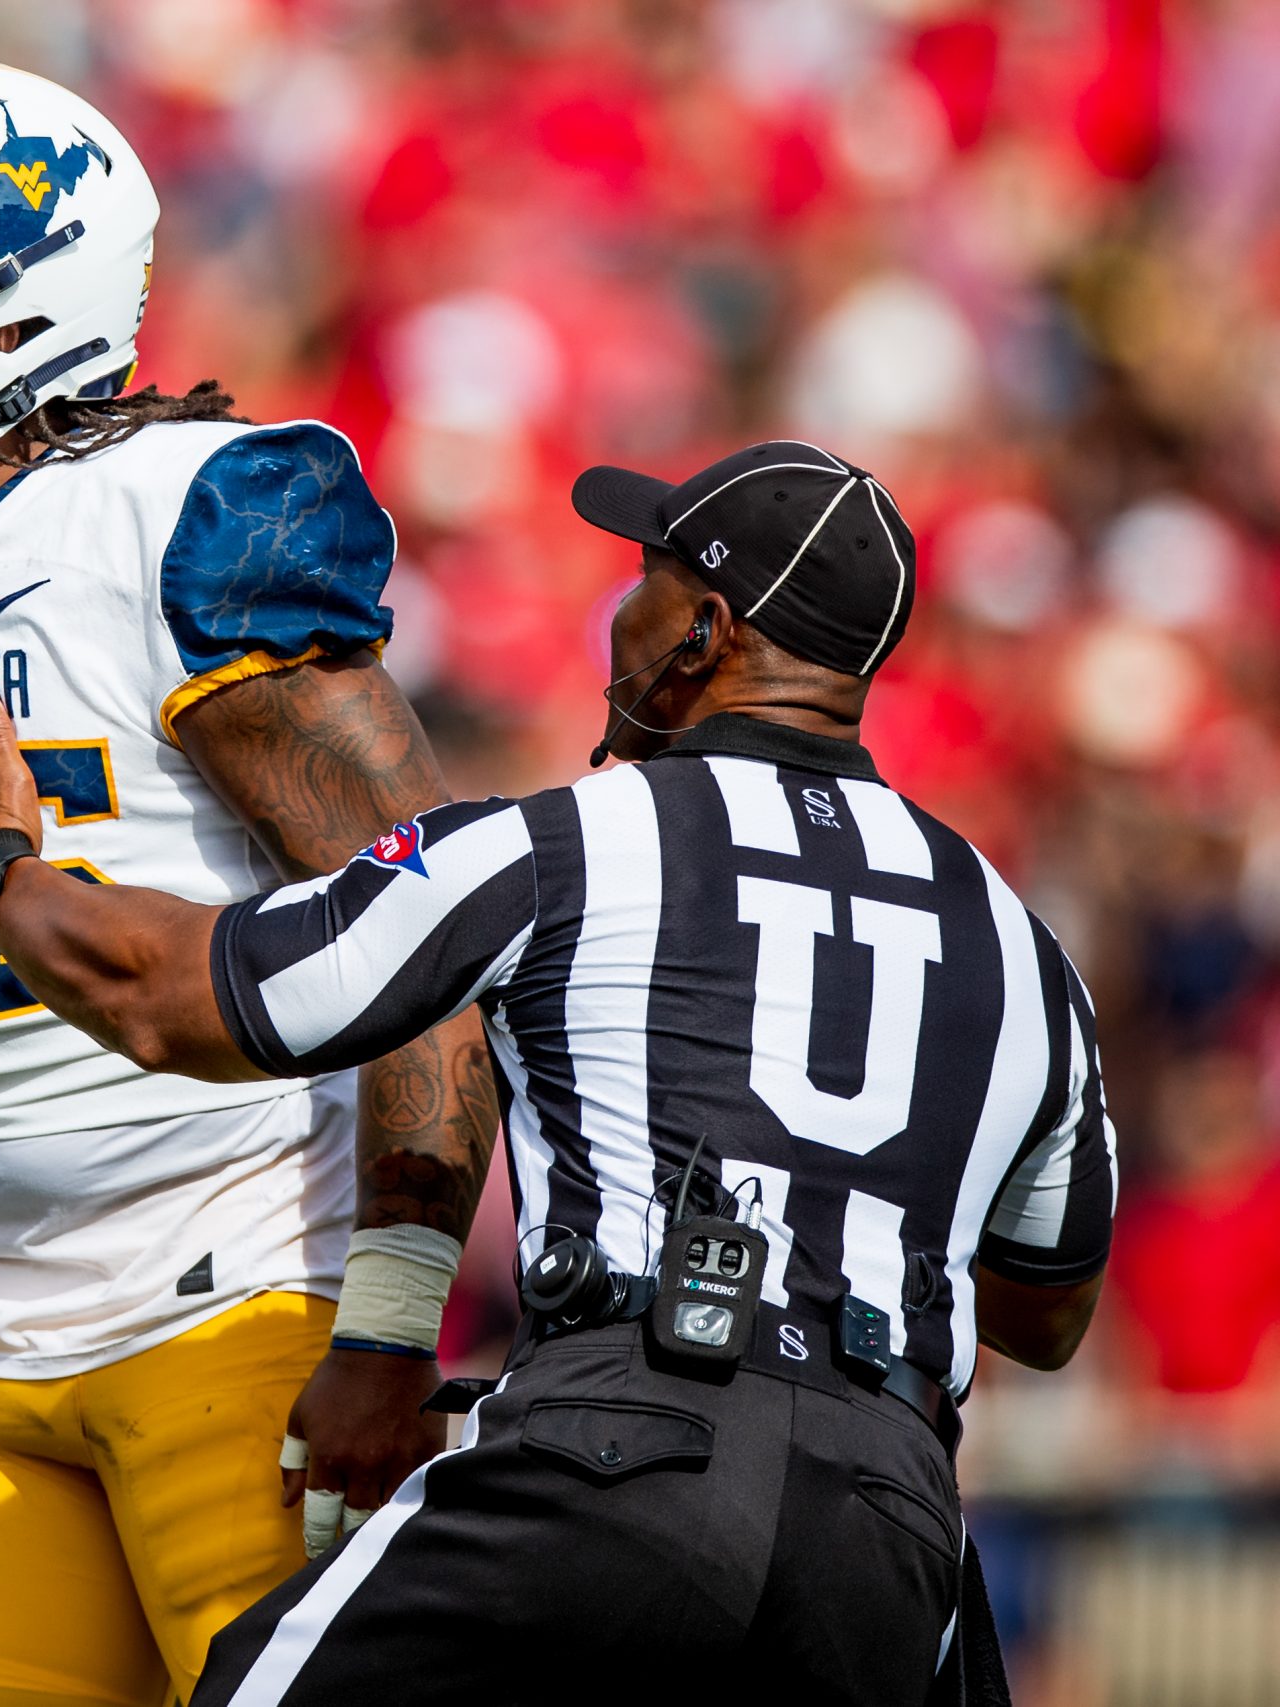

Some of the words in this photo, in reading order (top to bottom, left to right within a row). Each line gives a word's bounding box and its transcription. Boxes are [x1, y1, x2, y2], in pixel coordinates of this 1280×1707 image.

[810, 815, 842, 829] USA
[737, 875, 943, 1157] U
[683, 1278, 737, 1296] VOKKERO
